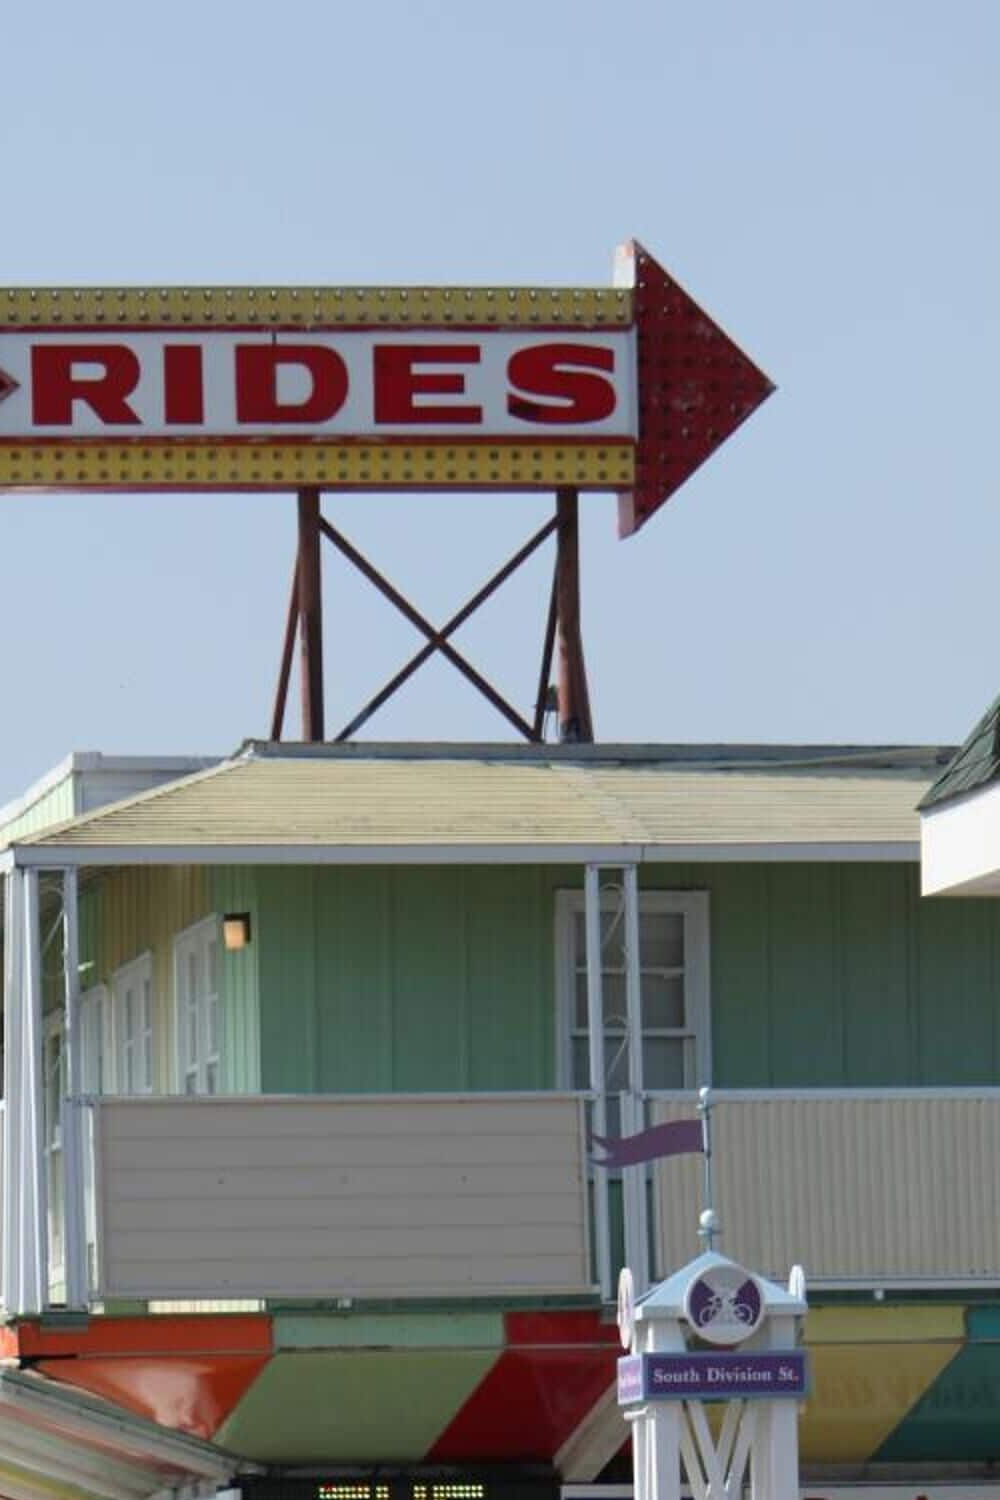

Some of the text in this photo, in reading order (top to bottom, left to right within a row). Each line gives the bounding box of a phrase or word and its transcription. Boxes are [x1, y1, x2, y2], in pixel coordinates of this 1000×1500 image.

[30, 344, 616, 426] RIDES
[653, 1367, 699, 1384] South
[706, 1366, 772, 1382] Division
[777, 1366, 799, 1381] St.
